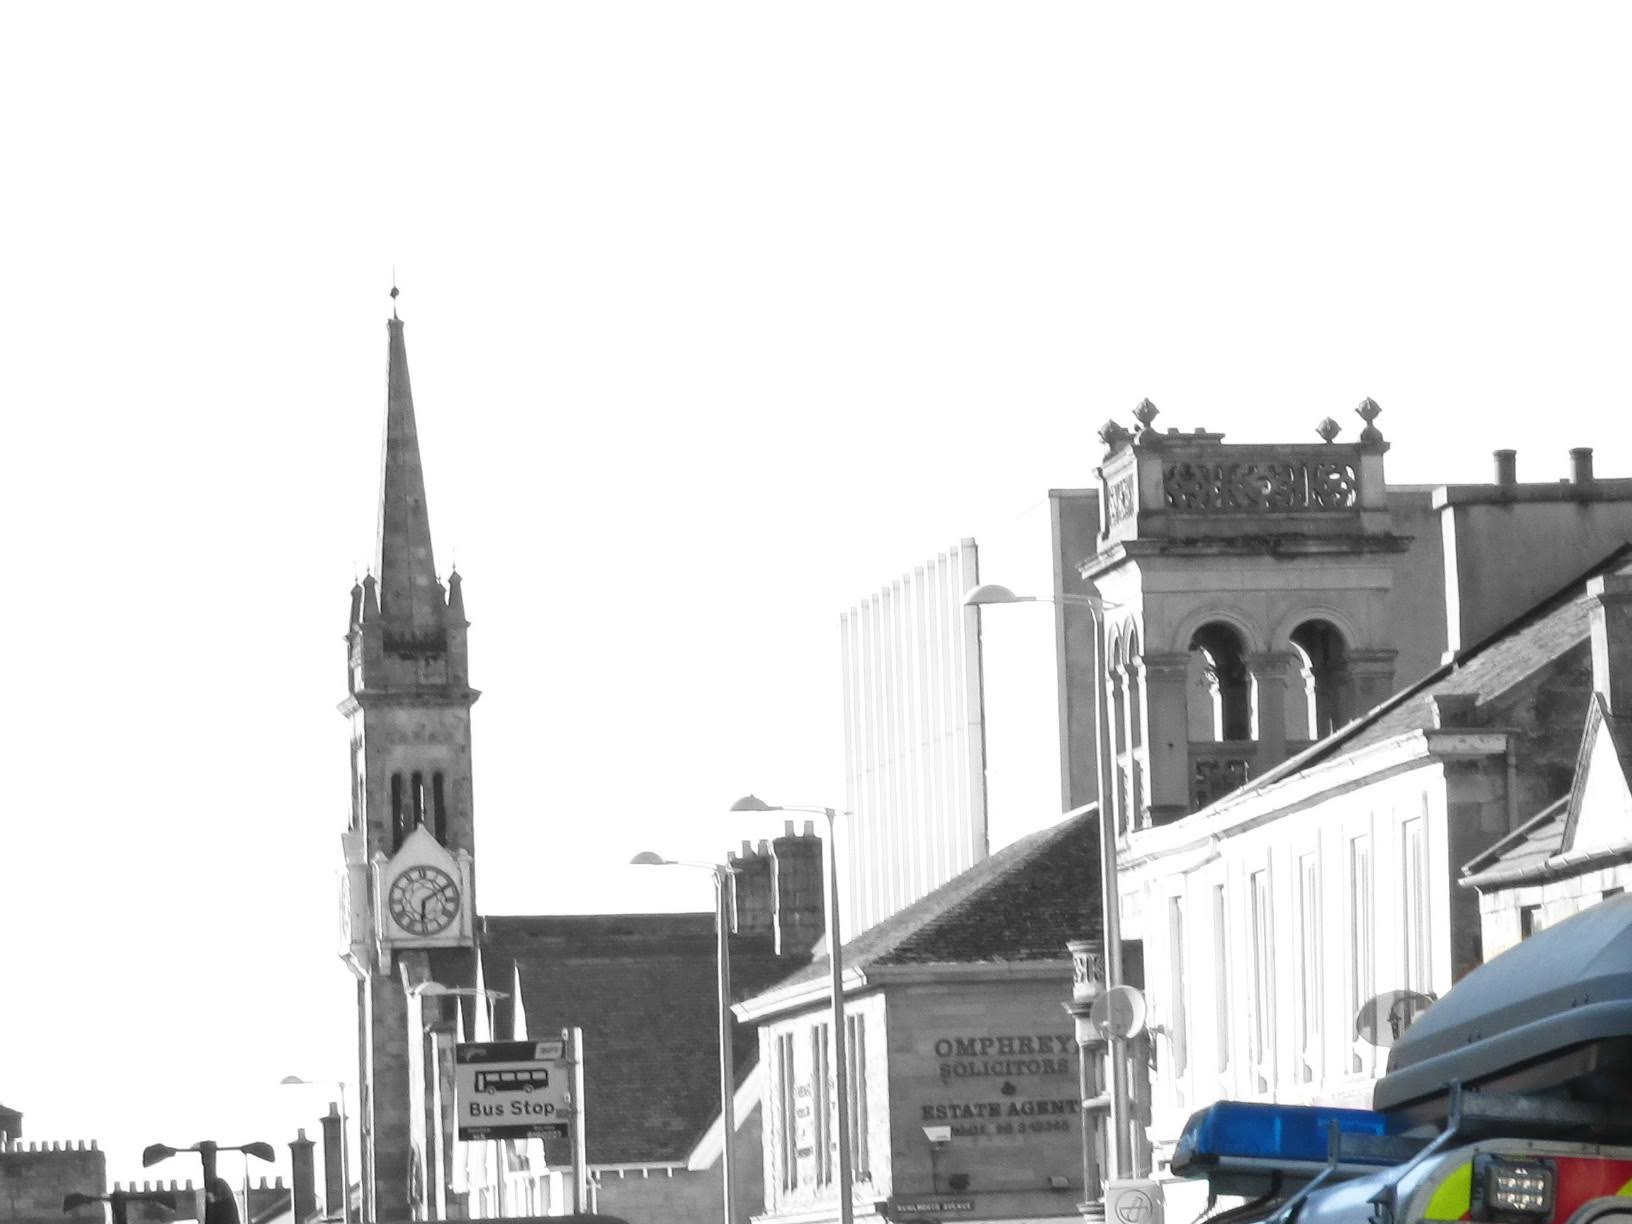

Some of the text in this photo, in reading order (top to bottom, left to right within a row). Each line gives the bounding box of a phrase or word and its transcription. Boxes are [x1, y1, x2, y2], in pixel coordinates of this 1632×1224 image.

[935, 1034, 1072, 1057] OMPHREY
[939, 1058, 1069, 1079] SOLICITORS
[470, 1100, 555, 1117] Bus Stop
[921, 1100, 1079, 1120] ESTATE AGENT
